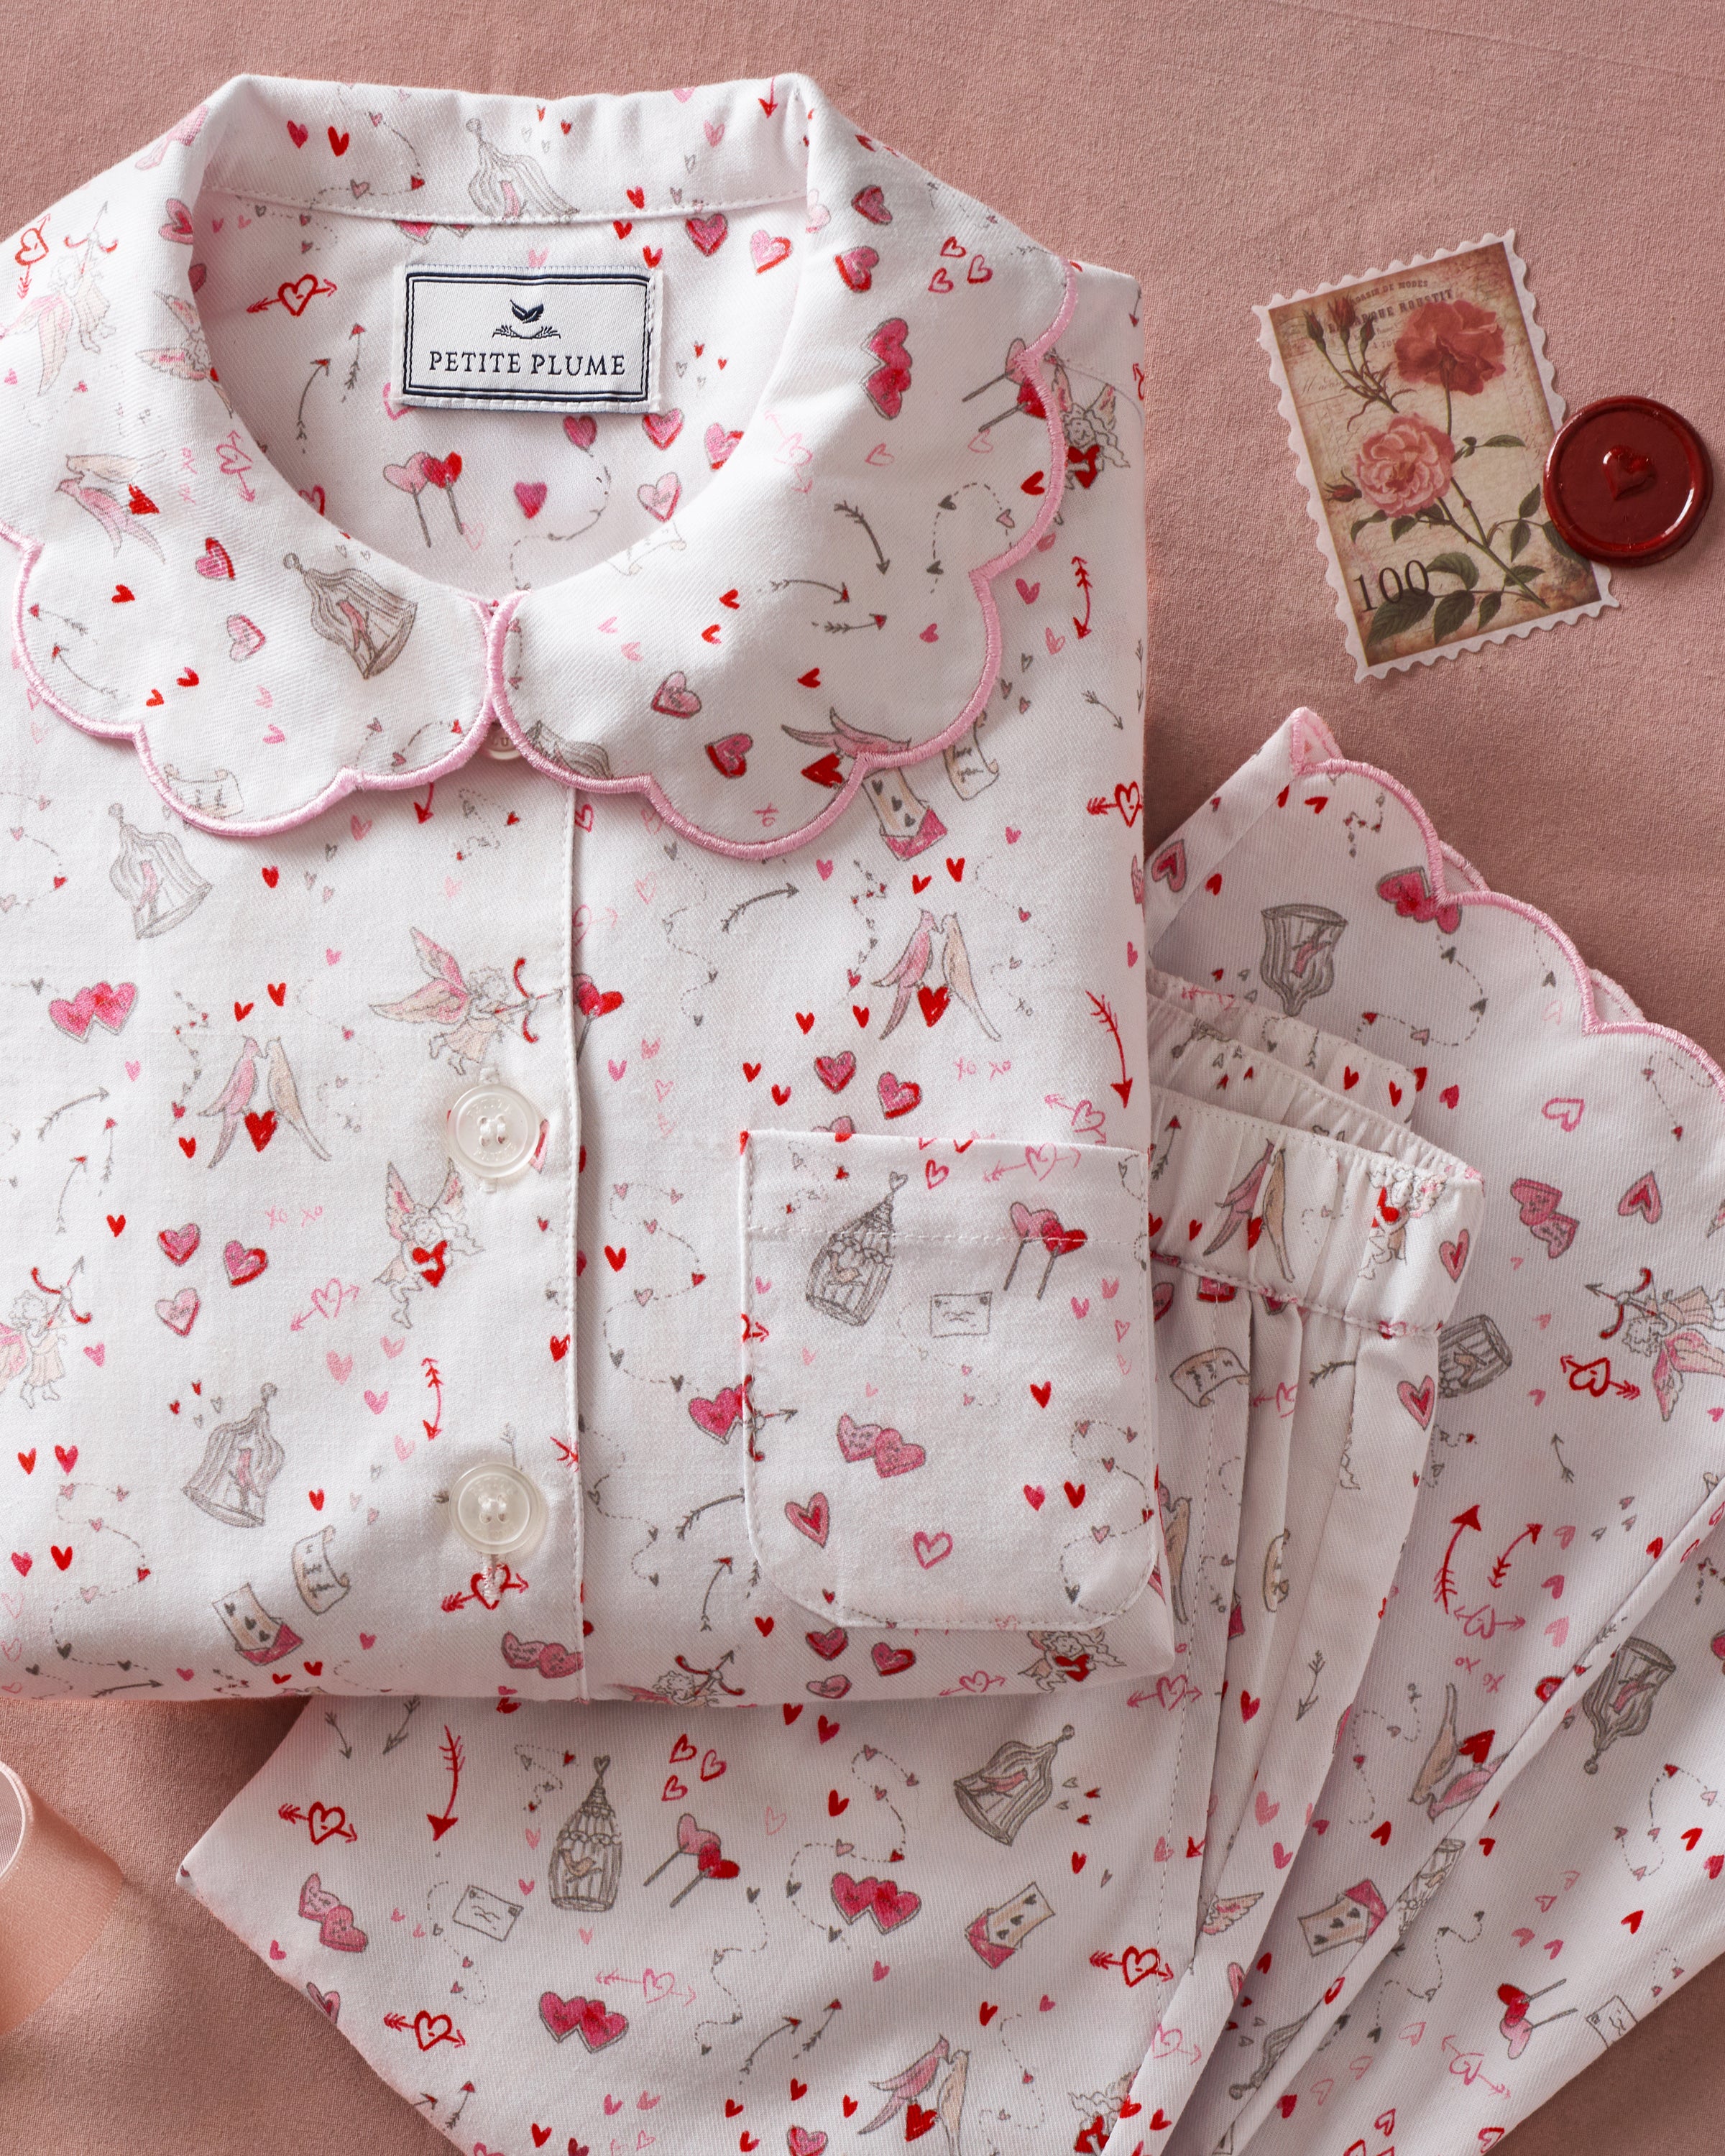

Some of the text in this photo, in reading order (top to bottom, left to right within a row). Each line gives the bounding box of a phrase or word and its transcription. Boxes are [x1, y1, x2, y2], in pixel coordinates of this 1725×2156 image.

[429, 351, 626, 376] PETITE PLUME
[1353, 561, 1430, 612] 100
